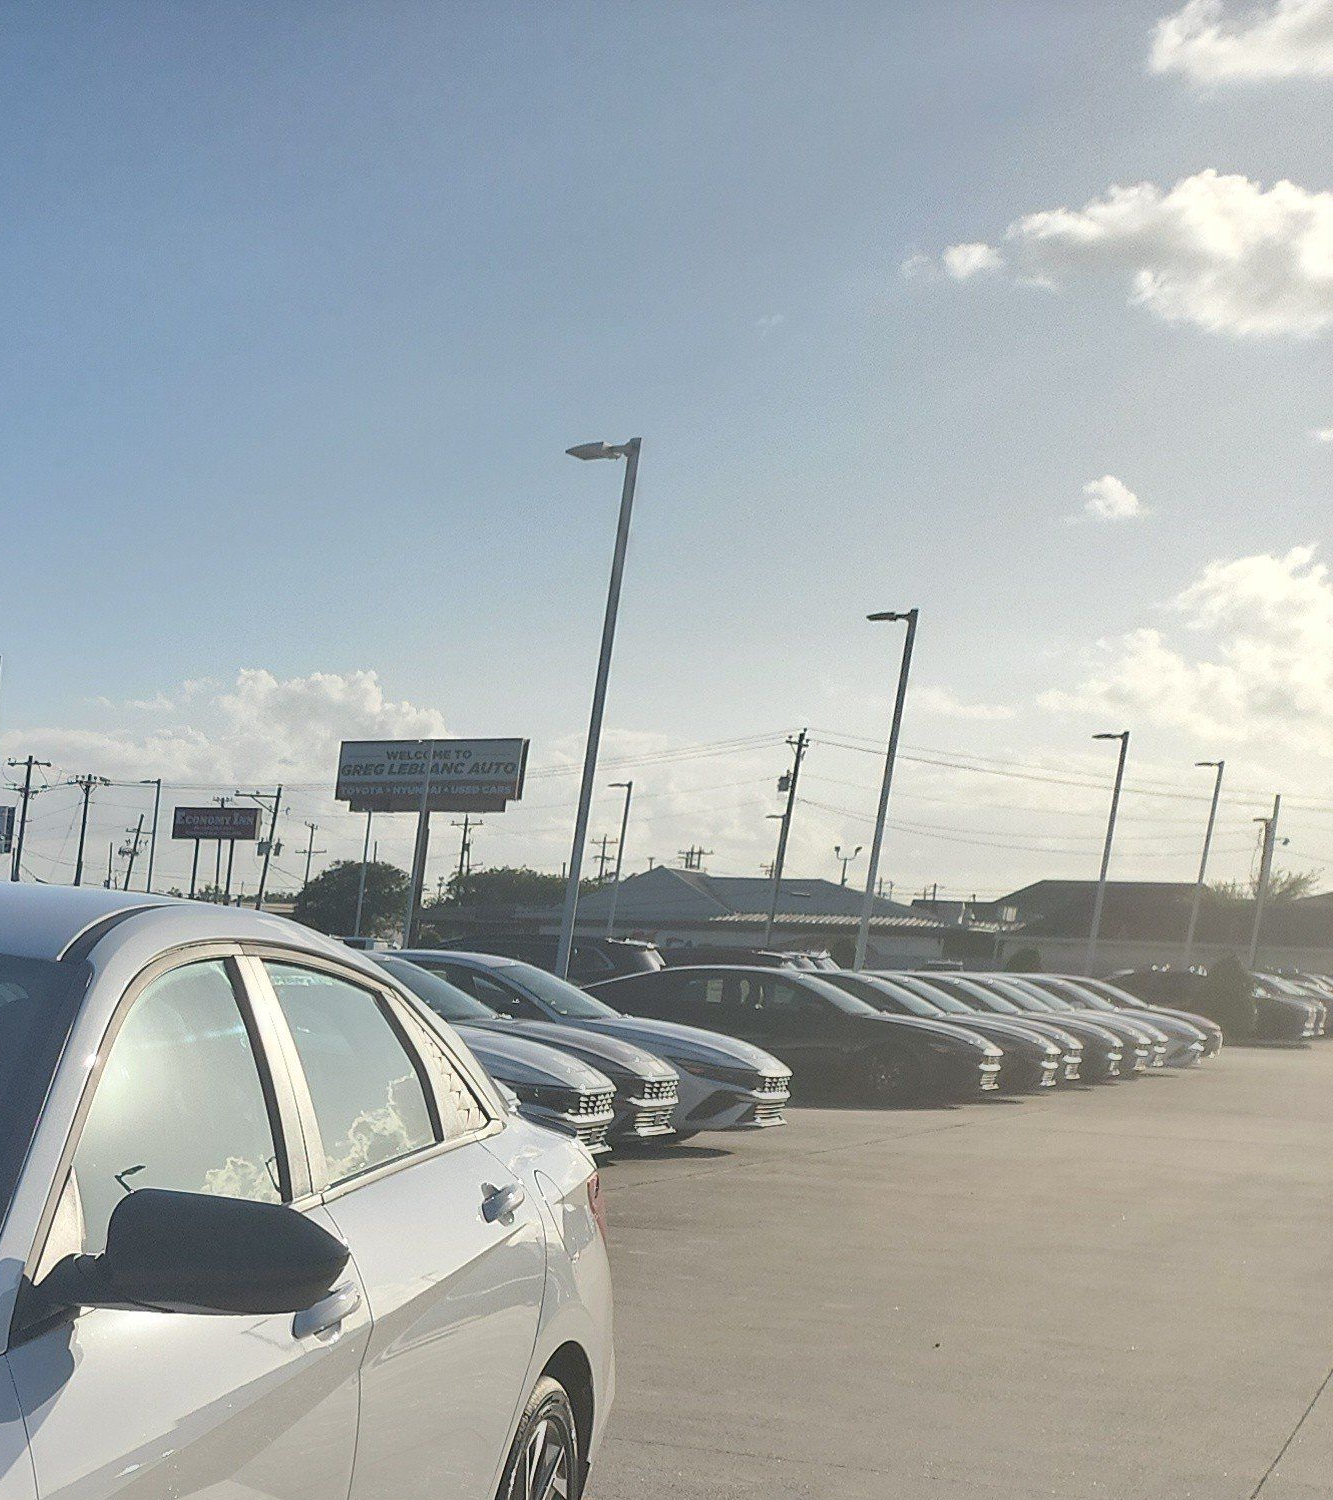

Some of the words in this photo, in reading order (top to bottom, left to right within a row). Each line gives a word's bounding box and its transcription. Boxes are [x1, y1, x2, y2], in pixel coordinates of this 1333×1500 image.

[454, 750, 473, 760] TO
[341, 764, 386, 777] GREG
[468, 762, 517, 775] AUTO
[341, 786, 384, 796] TOYOTA
[392, 786, 442, 795] HYUNAI
[450, 785, 480, 794] USED
[483, 785, 512, 794] CARS
[176, 811, 231, 825] ECONOMY
[233, 812, 254, 825] INN
